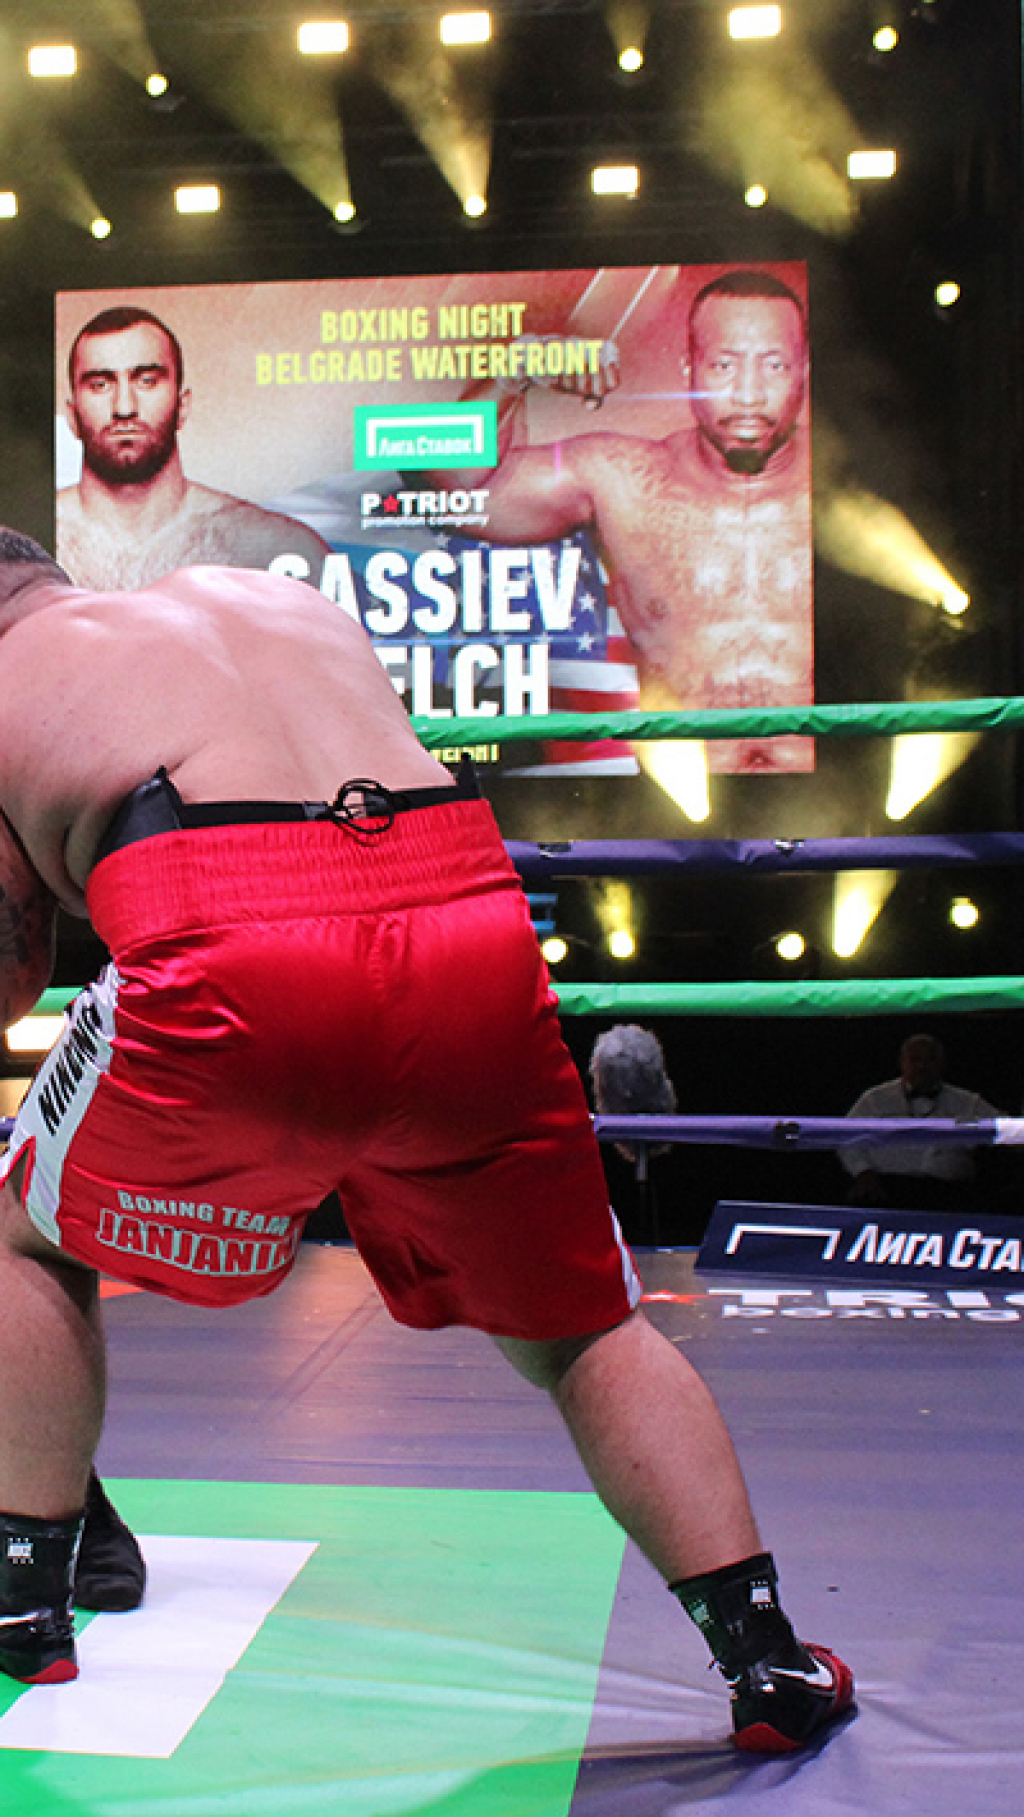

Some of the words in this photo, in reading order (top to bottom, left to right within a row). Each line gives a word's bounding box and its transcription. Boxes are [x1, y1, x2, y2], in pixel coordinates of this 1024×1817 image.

[320, 307, 429, 344] BOXING
[438, 302, 527, 339] NIGHT
[256, 348, 403, 386] BELGRADE
[410, 340, 605, 380] WATERFRONT
[117, 1189, 215, 1223] BOXING
[222, 1207, 291, 1237] TEAM
[947, 1229, 1024, 1273] СТА
